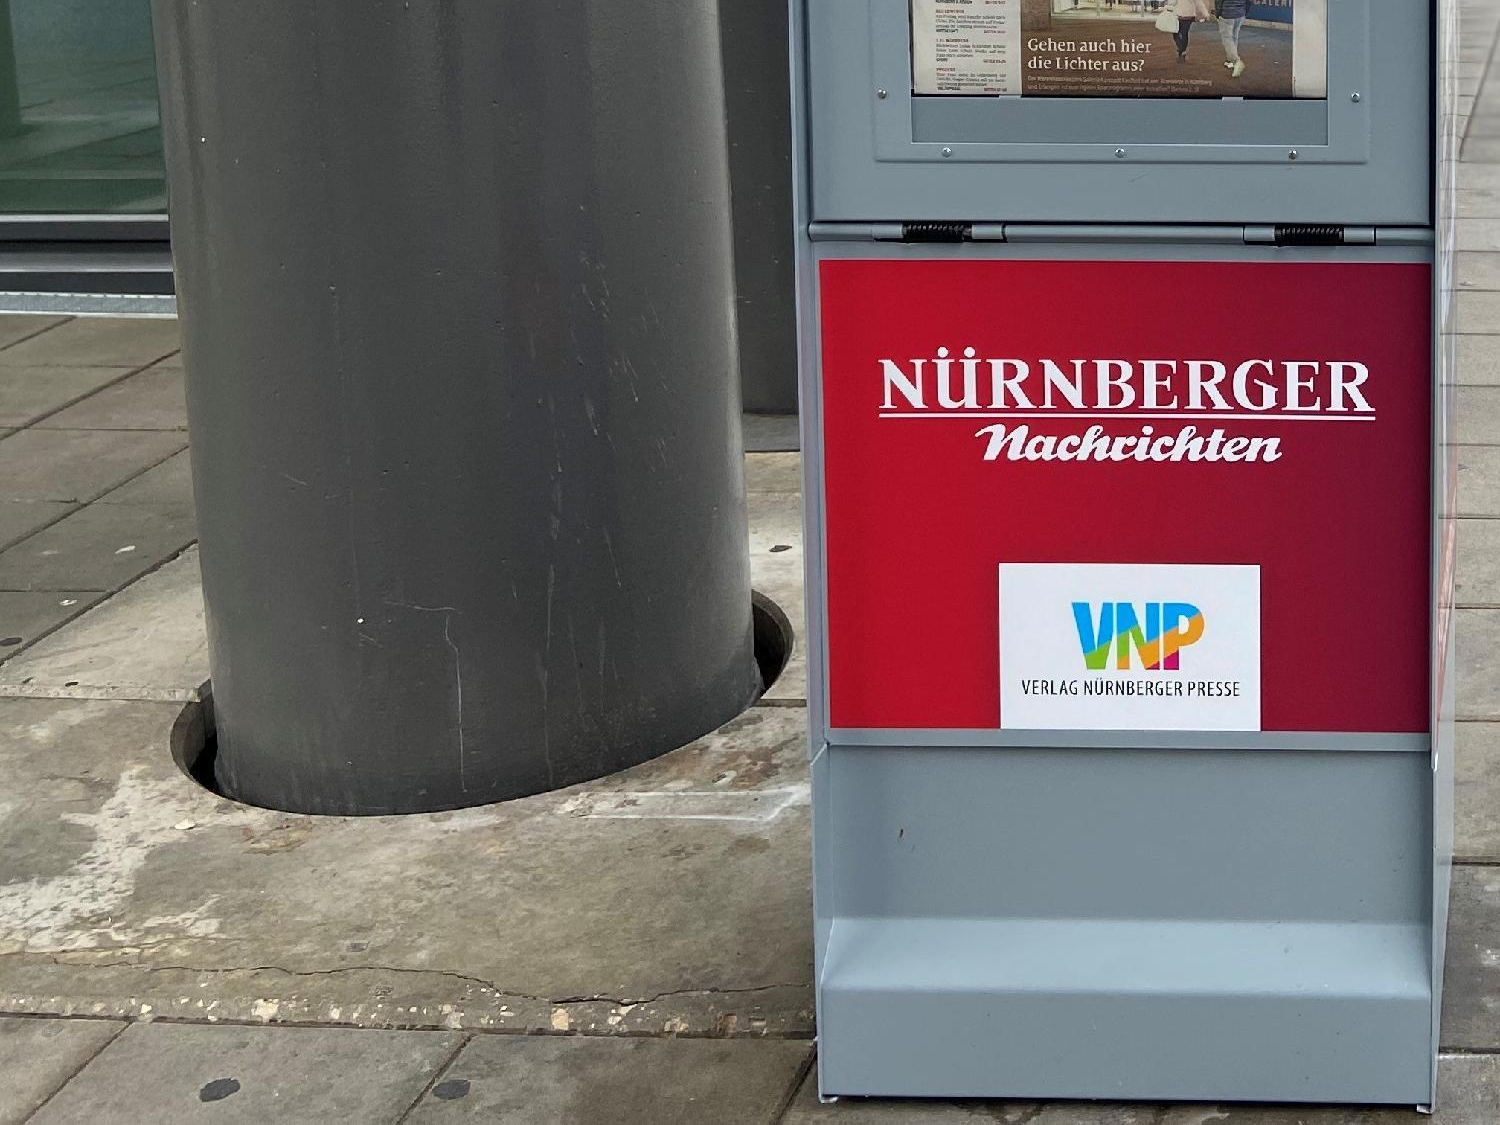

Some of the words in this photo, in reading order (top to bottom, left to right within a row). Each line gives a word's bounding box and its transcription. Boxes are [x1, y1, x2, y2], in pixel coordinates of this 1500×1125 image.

[1027, 37, 1076, 52] Gehen
[1079, 38, 1116, 53] auch
[1120, 38, 1152, 53] hier
[1027, 55, 1052, 69] die
[1055, 56, 1110, 71] Lichter
[1111, 59, 1145, 72] aus?
[877, 346, 1376, 412] NÜRNBERGER
[974, 423, 1283, 463] Nachrichten
[1070, 601, 1206, 671] VNP
[1021, 679, 1078, 697] VERLAG
[1083, 677, 1184, 697] NÜRNBERGER
[1187, 681, 1241, 697] PRESSE
